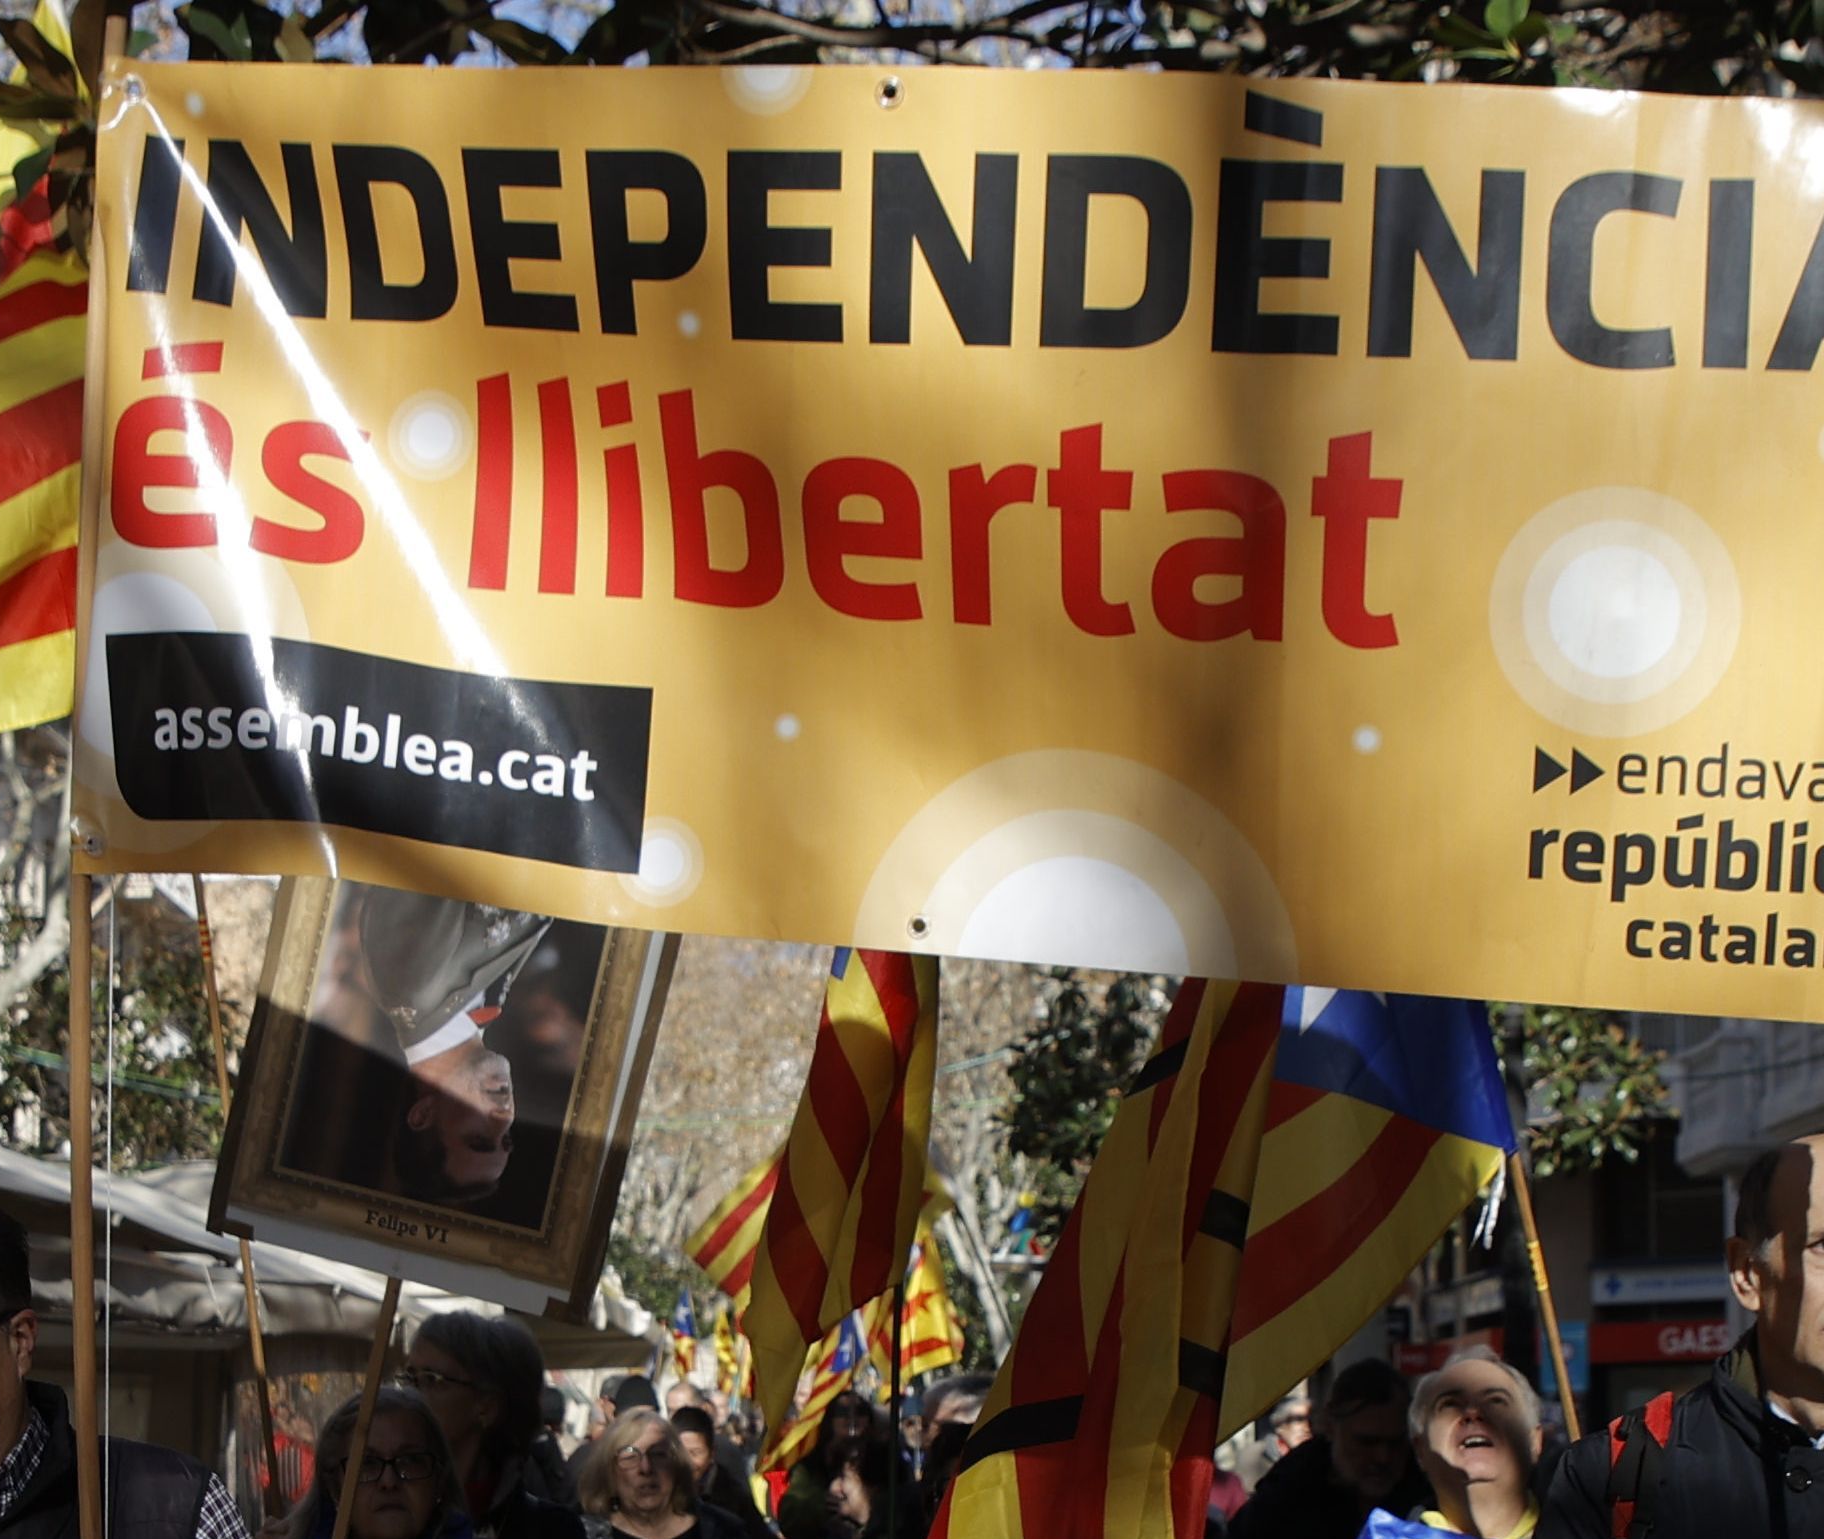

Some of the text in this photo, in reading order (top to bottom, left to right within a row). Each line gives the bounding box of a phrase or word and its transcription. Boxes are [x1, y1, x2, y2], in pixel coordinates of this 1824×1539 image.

[111, 341, 1404, 649] és llibertat
[153, 706, 598, 802] assemblea.cat
[365, 1209, 449, 1244] Felipe VI
